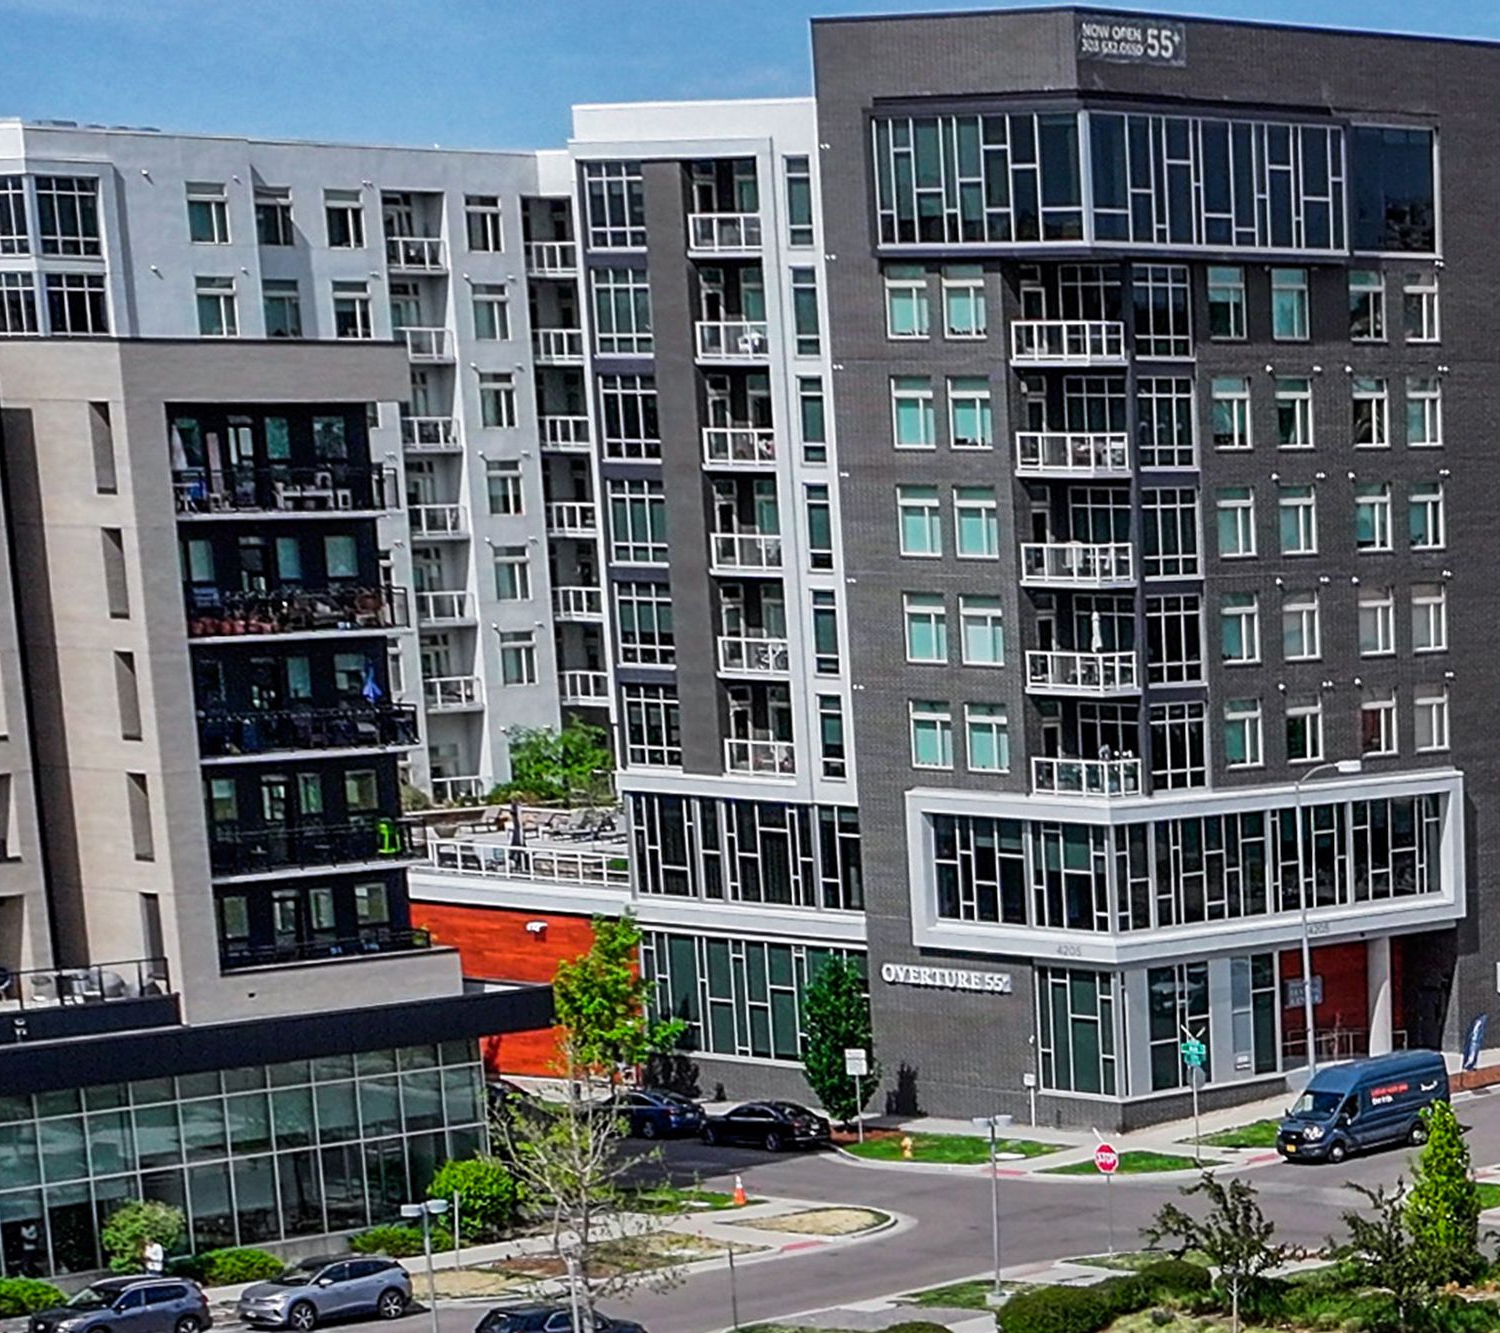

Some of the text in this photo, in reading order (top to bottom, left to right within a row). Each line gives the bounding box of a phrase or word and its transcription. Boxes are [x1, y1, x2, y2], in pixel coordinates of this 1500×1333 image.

[1082, 22, 1142, 42] NOW OPEN
[881, 963, 982, 989] OVERTURE
[1095, 1151, 1116, 1164] STOP
